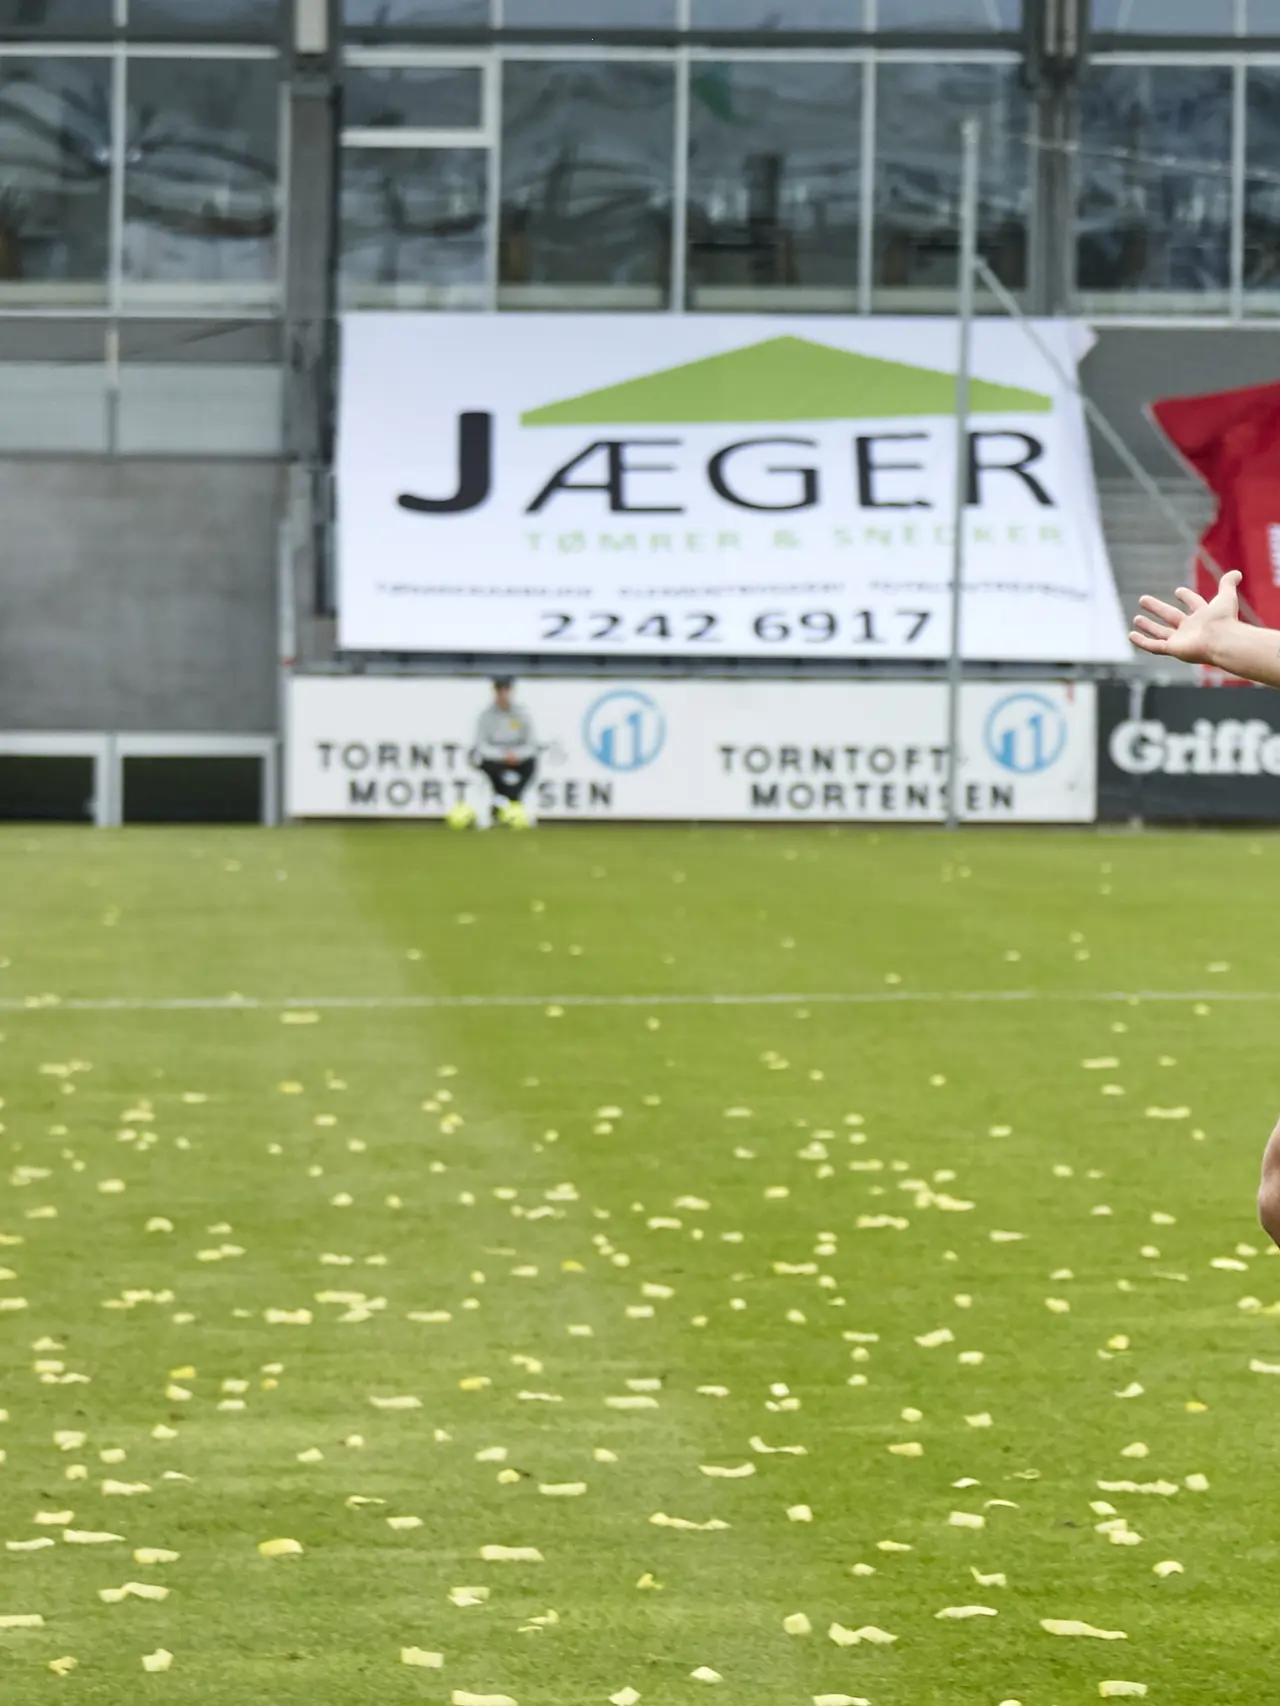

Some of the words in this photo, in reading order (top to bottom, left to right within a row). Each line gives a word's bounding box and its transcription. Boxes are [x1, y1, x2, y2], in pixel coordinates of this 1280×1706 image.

[396, 411, 1056, 515] JÆGER
[540, 610, 724, 643] 2242
[753, 609, 932, 644] 6917
[317, 742, 550, 771] TORNT
[720, 745, 952, 775] TORNTOFT
[350, 780, 614, 807] MORTSEN
